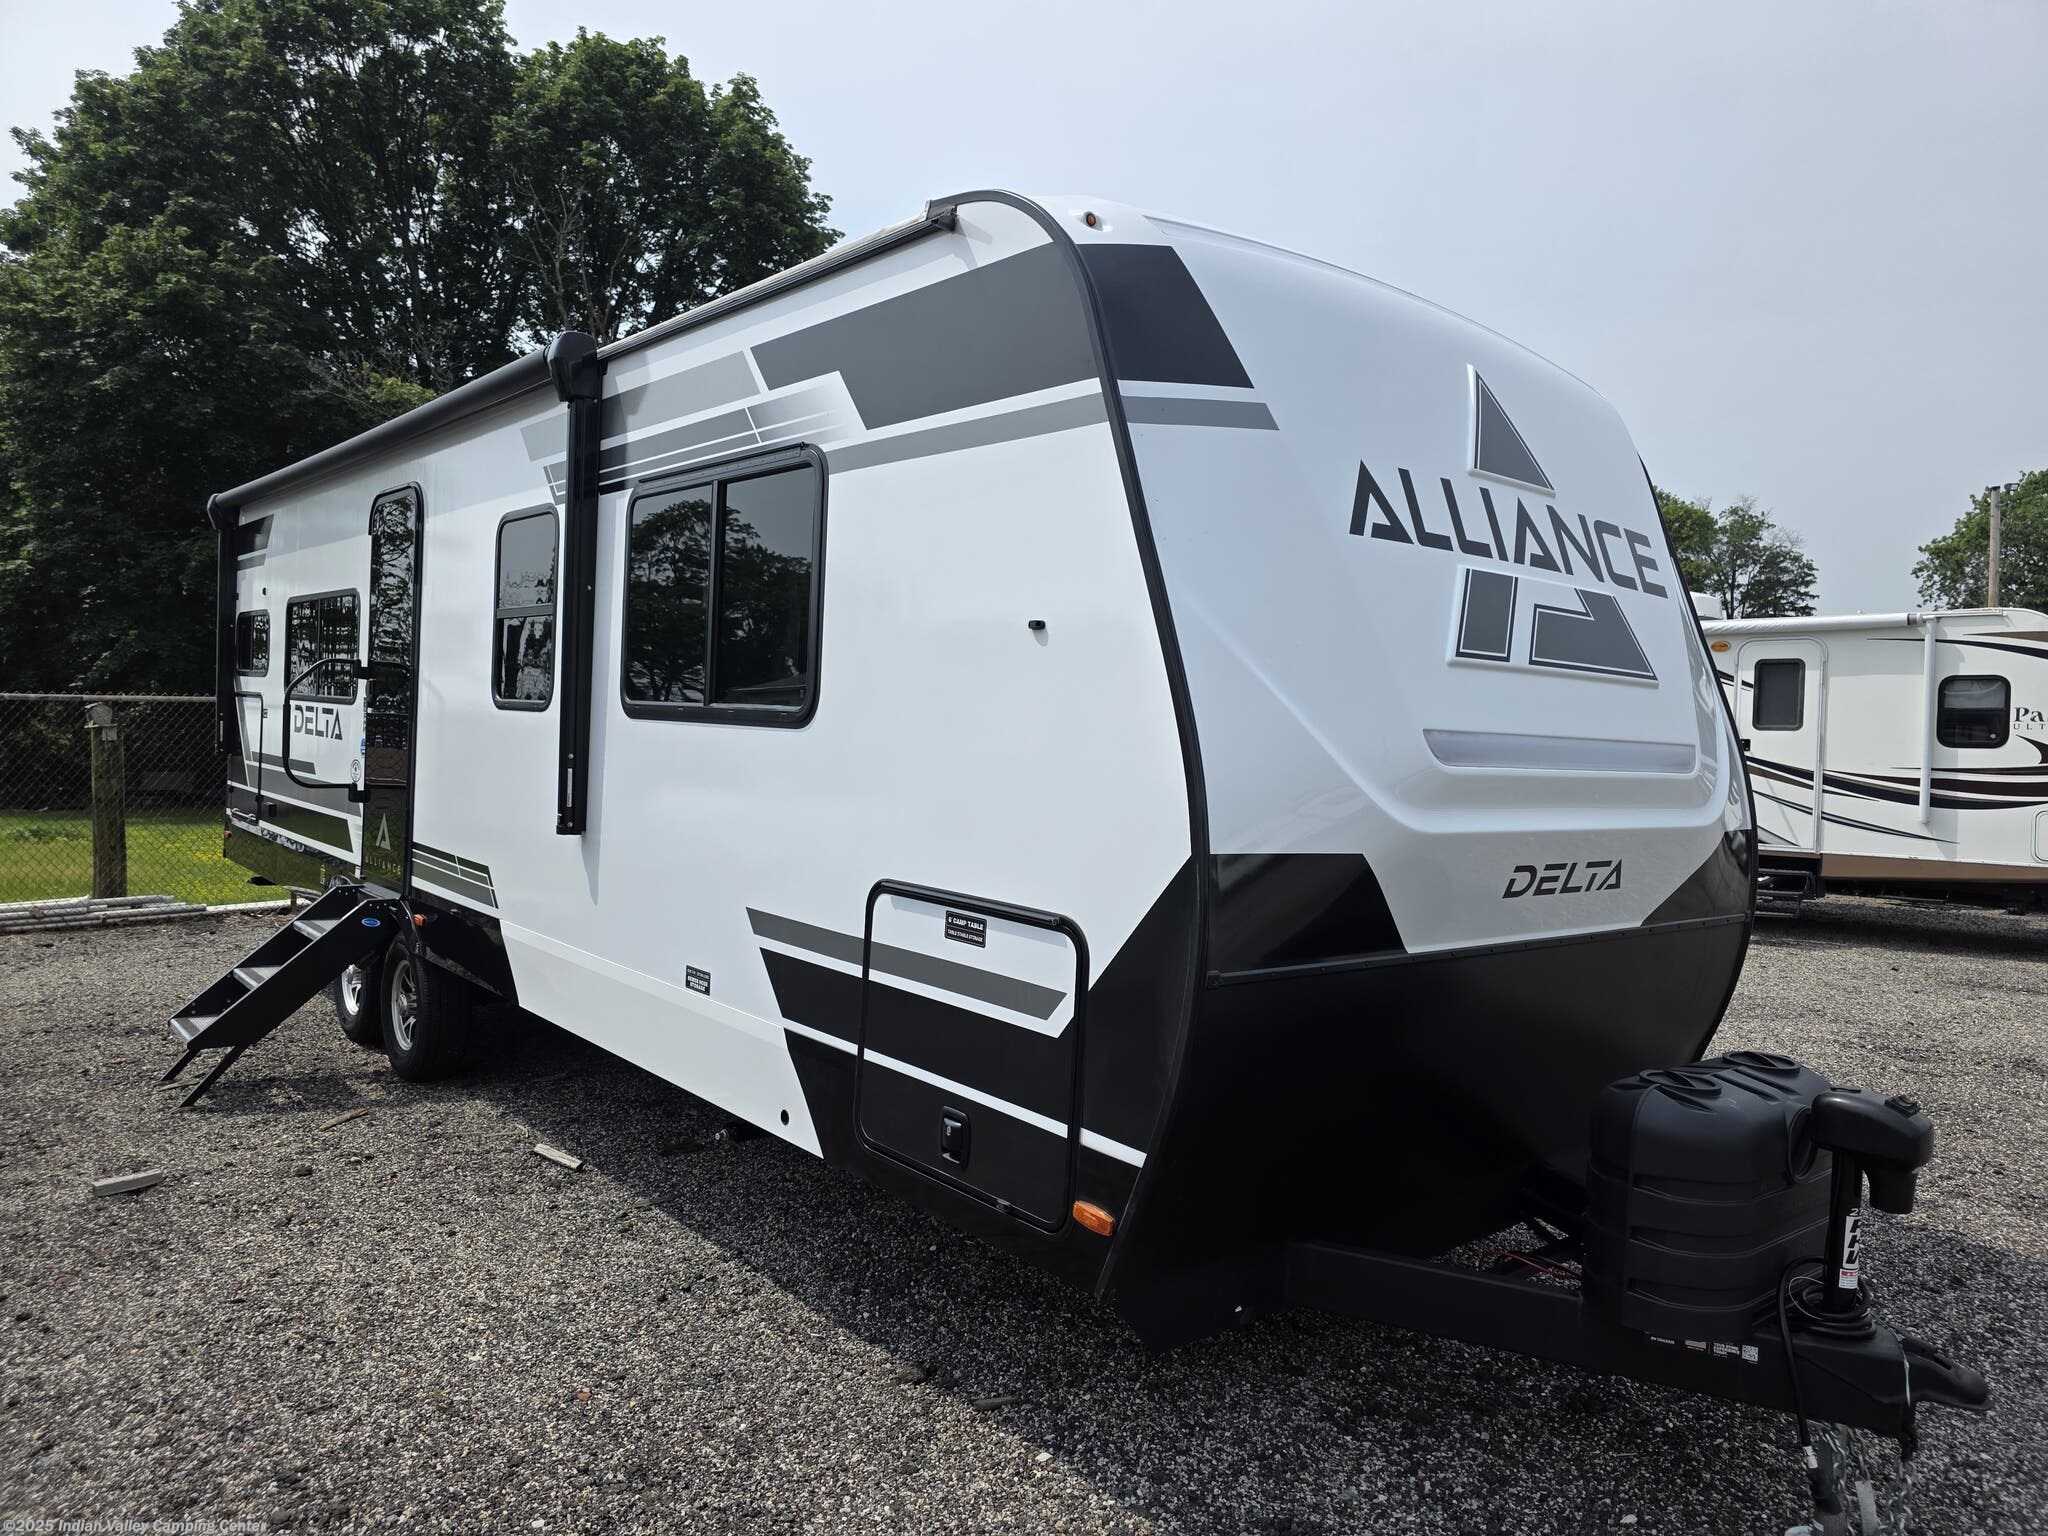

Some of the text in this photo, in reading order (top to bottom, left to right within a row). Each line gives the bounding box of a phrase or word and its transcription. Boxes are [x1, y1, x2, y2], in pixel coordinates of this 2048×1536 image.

[1349, 459, 1668, 599] ALLIANCE
[294, 704, 343, 741] DELTA
[2013, 706, 2048, 722] Pa
[365, 855, 401, 875] ALLIANCE
[1502, 859, 1622, 899] DELTA
[953, 917, 967, 925] CAMP
[968, 921, 984, 930] TABLE
